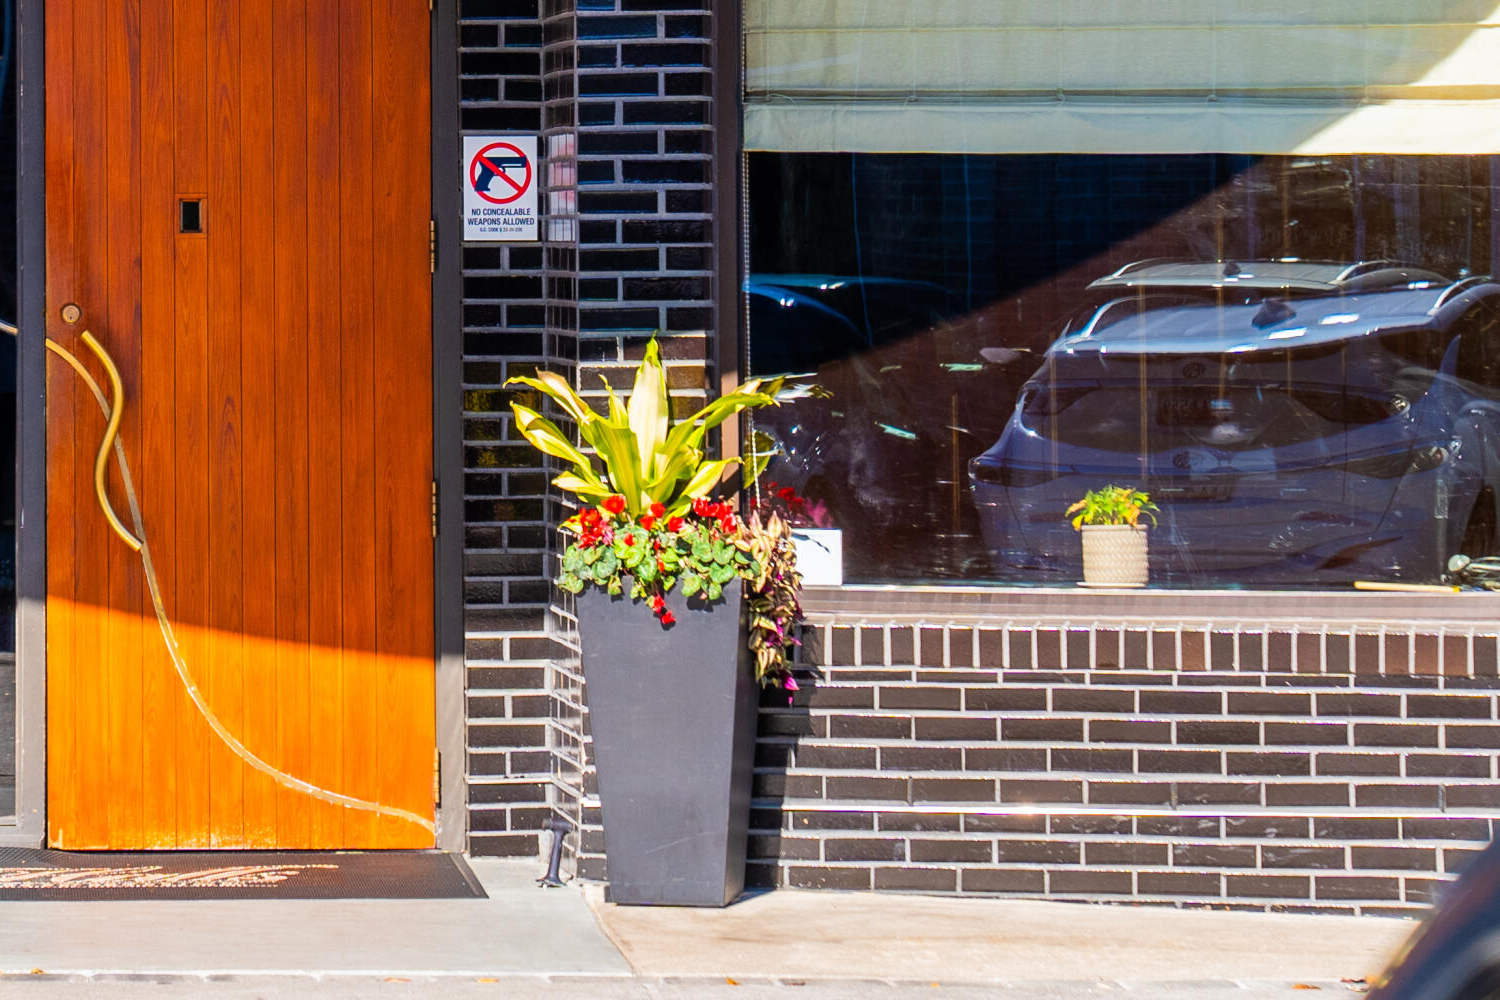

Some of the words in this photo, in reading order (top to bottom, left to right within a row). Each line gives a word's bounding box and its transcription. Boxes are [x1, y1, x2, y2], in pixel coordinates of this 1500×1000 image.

[471, 208, 481, 216] NO
[482, 208, 531, 216] CONCEALABLE
[467, 217, 501, 226] WEAPONS
[502, 217, 535, 226] ALLOWED
